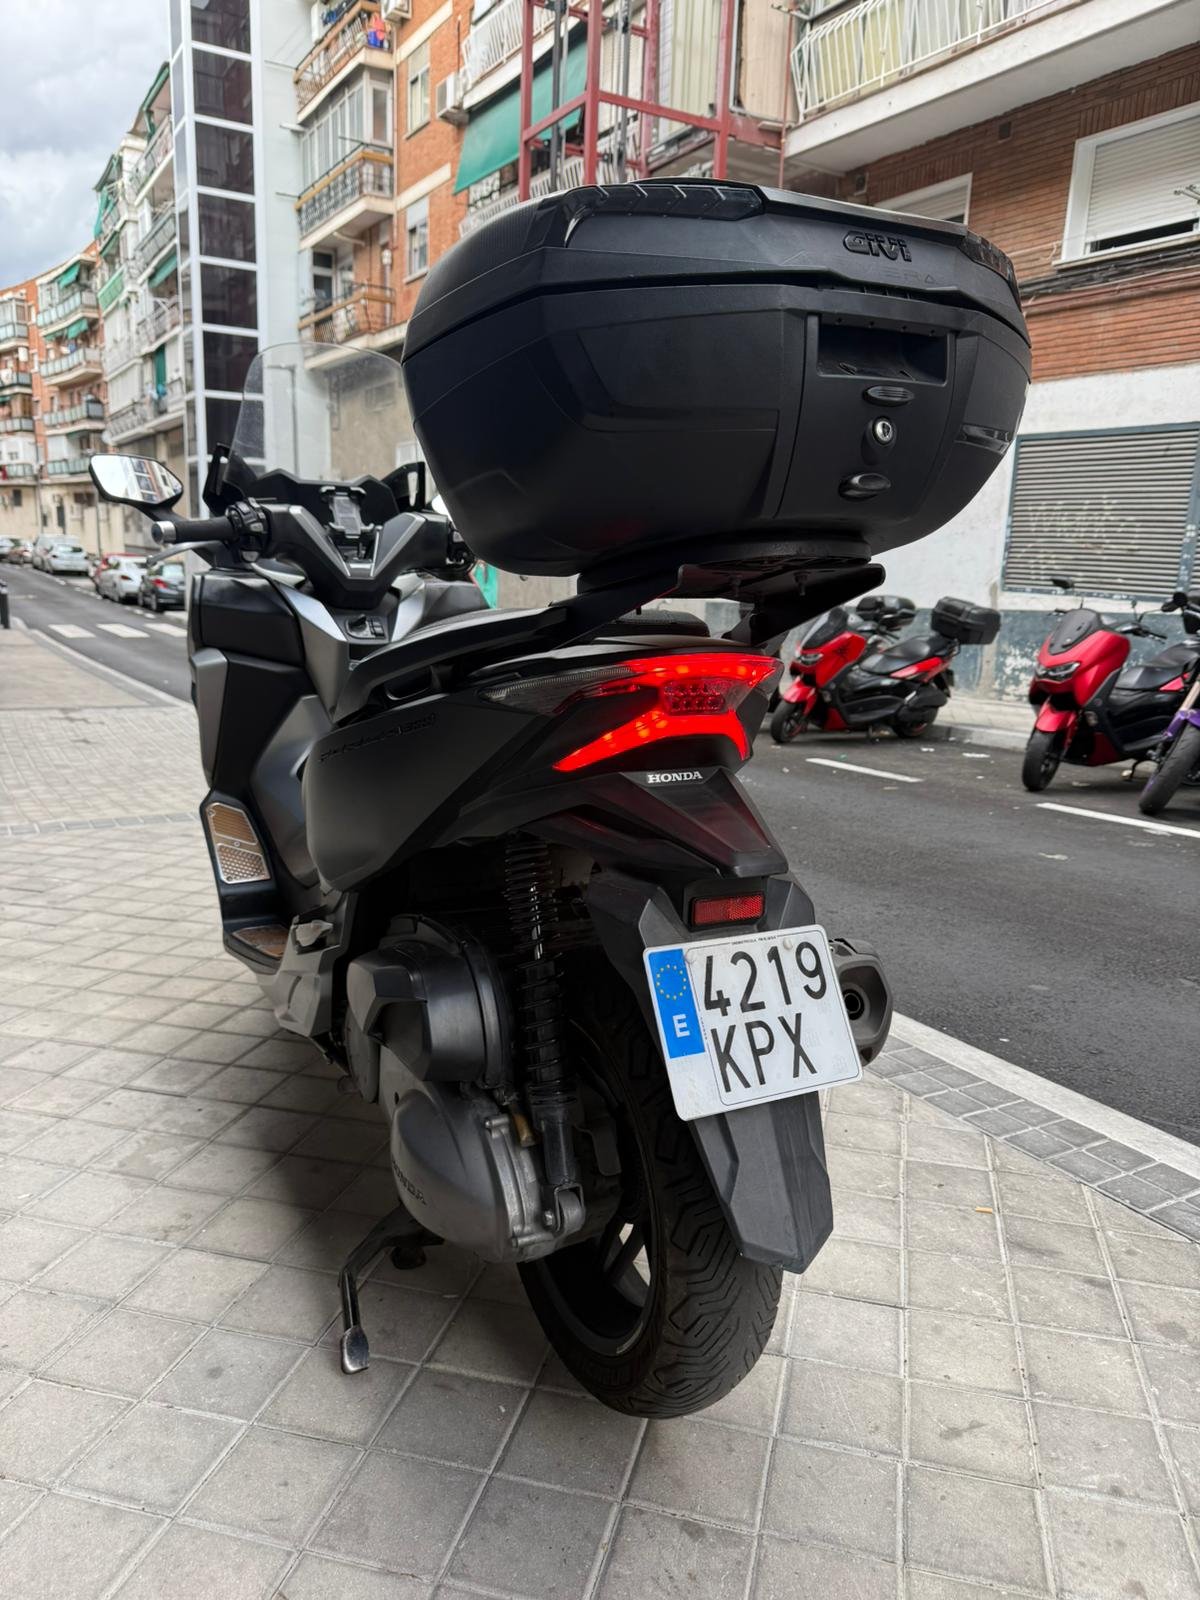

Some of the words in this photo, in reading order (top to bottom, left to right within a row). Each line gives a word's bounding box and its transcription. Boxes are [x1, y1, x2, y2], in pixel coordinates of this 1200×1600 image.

[647, 771, 703, 783] HONDA
[704, 941, 827, 1017] 4219
[672, 1013, 690, 1038] E
[710, 1012, 818, 1093] KPX
